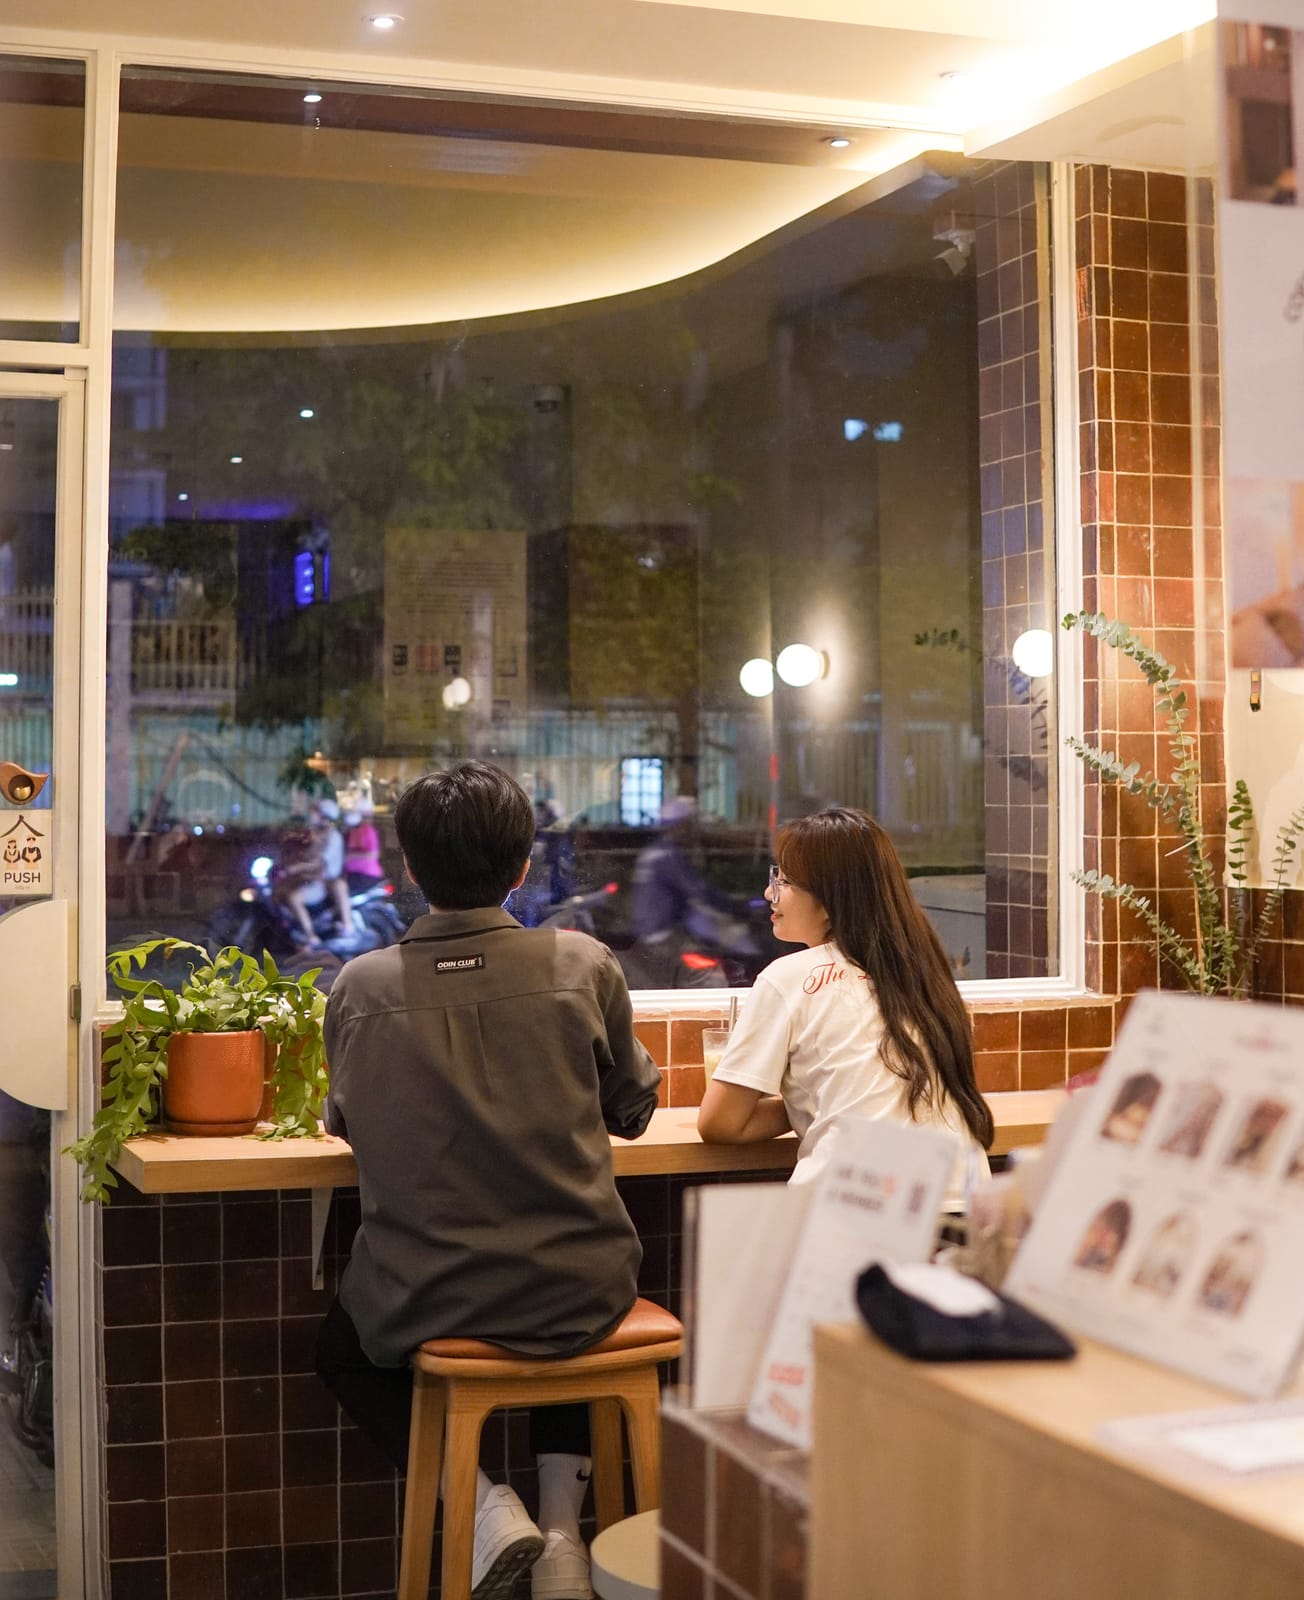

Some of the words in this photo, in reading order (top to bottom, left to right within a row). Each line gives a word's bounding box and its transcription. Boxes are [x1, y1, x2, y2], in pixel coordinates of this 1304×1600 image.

[4, 872, 41, 883] PUSH
[437, 961, 456, 969] ODIN
[457, 958, 476, 967] CLUB
[803, 962, 848, 994] The
